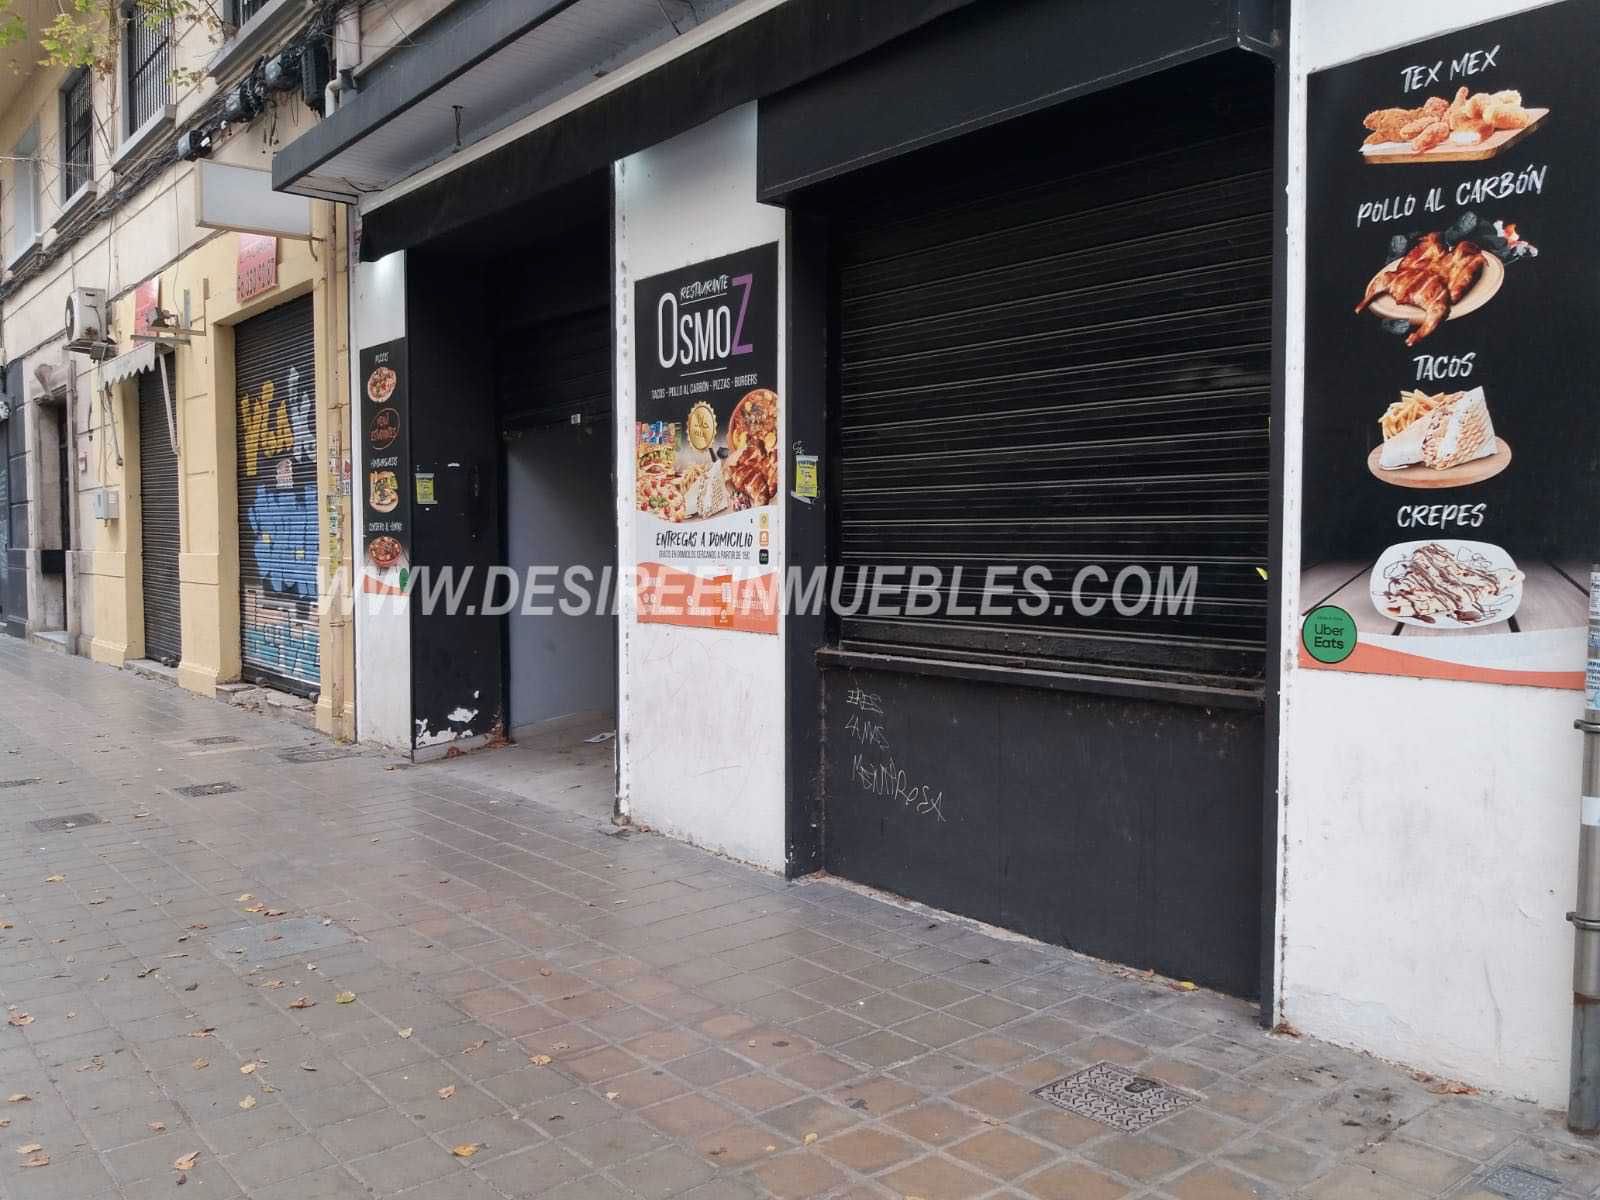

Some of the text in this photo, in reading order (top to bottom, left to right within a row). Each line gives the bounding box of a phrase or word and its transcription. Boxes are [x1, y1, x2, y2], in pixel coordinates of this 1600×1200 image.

[1400, 44, 1501, 93] TEX MEX
[1356, 163, 1548, 228] POLLO AL CARBÓN
[1413, 351, 1476, 381] TACOS
[1396, 502, 1487, 530] CREPES
[656, 530, 753, 549] ENTREGAS A DOMICILIO
[1314, 623, 1344, 636] Uber
[1314, 636, 1345, 650] Eats
